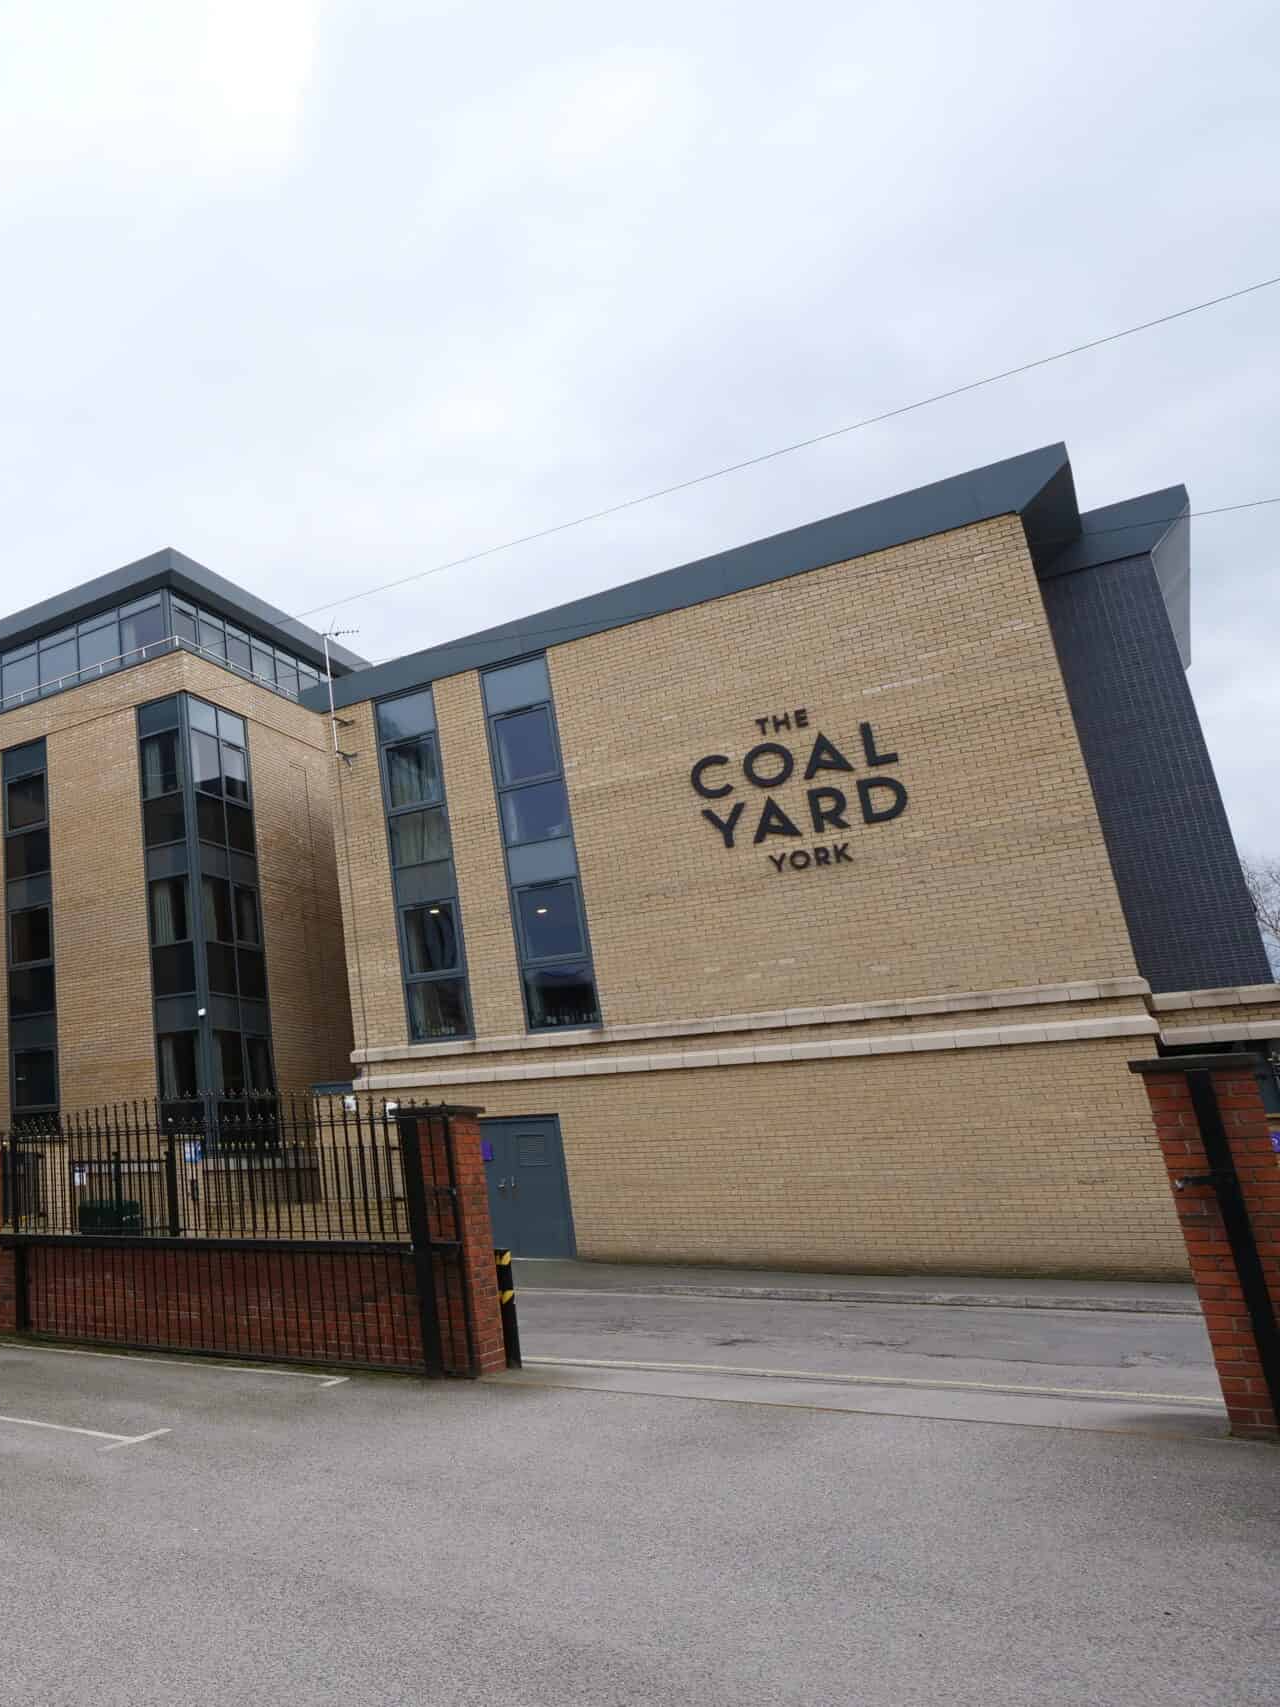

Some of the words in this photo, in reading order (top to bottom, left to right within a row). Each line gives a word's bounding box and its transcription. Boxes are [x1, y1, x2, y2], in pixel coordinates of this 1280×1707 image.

[755, 708, 809, 735] THE
[690, 721, 899, 799] COAL
[701, 777, 908, 849] YARD
[768, 843, 854, 873] YORK
